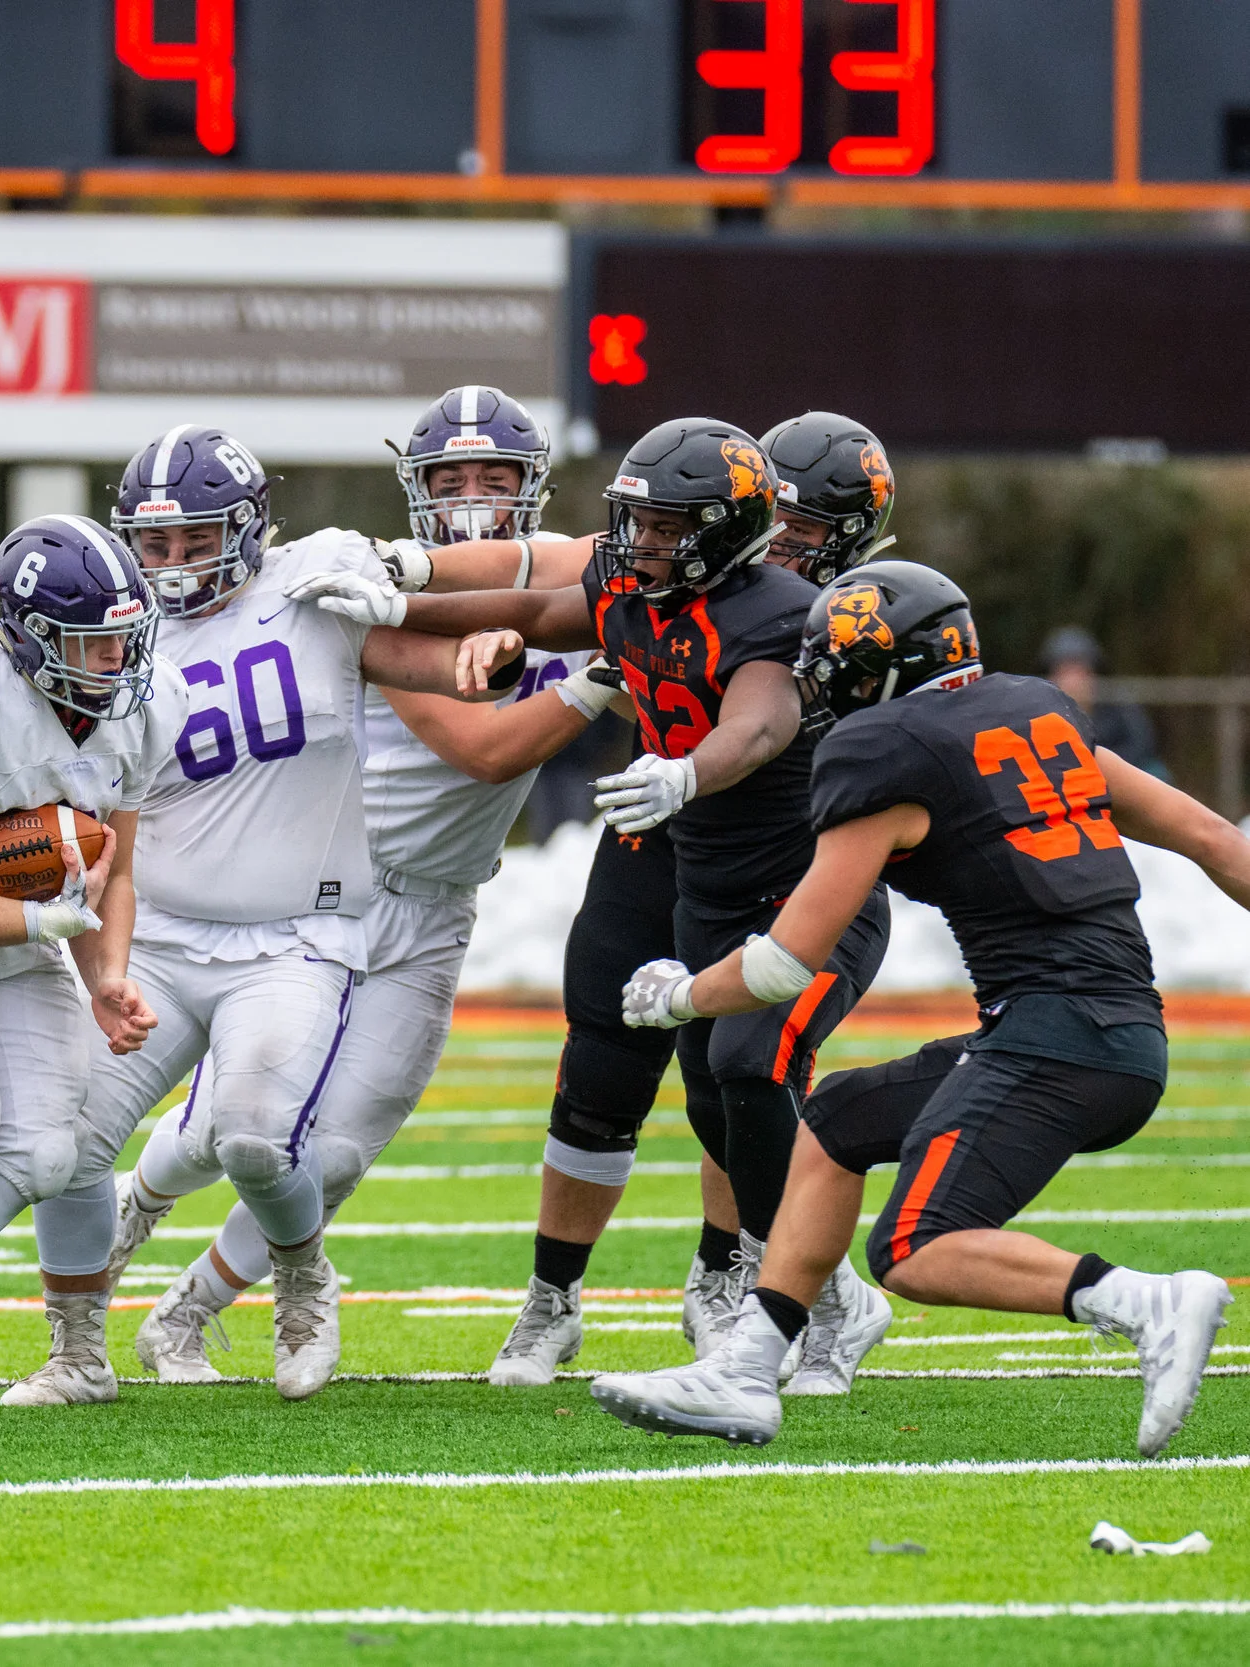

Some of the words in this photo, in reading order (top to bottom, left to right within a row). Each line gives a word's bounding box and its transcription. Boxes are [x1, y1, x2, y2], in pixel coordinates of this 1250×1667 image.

[696, 0, 935, 176] 33
[214, 437, 262, 485] 60
[139, 503, 175, 514] Riddell
[13, 551, 48, 599] 6
[111, 601, 142, 619] Riddell
[649, 654, 687, 680] VILLE
[174, 639, 307, 782] 60
[973, 712, 1125, 862] 32
[322, 884, 339, 894] 2XL
